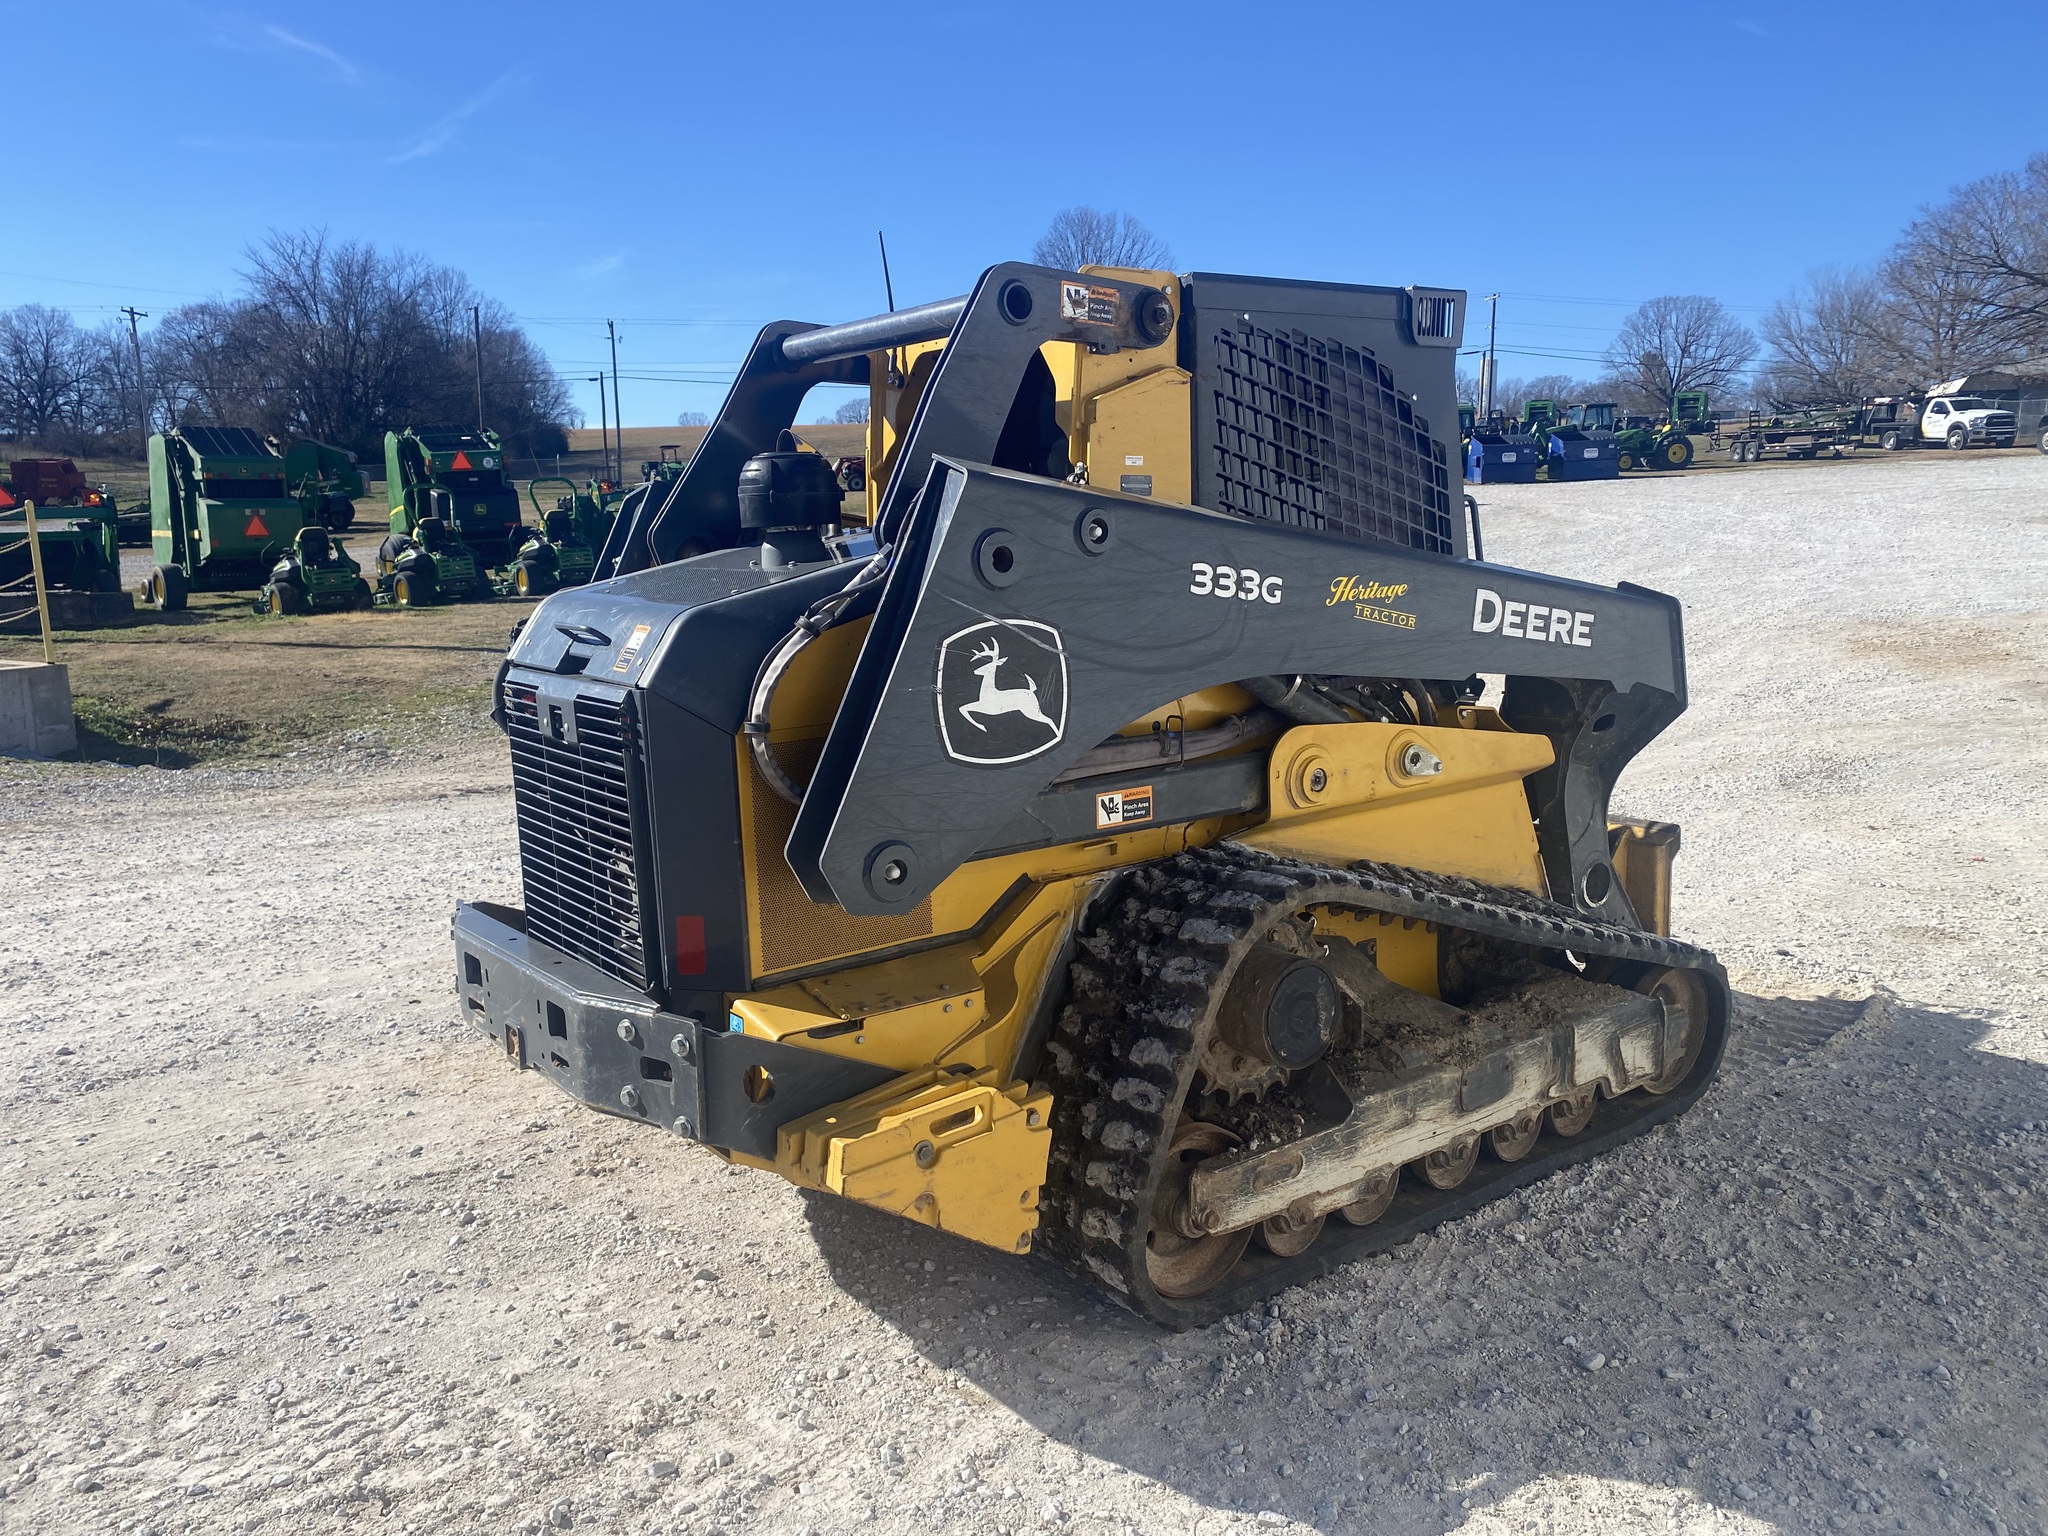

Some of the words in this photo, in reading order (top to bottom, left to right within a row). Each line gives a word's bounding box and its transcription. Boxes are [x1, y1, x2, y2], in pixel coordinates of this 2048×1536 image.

[1190, 562, 1283, 604] 333G
[1325, 575, 1409, 607] Heritage
[1355, 605, 1416, 627] TRACTOR
[1472, 588, 1595, 647] DEERE
[1135, 809, 1146, 817] Away
